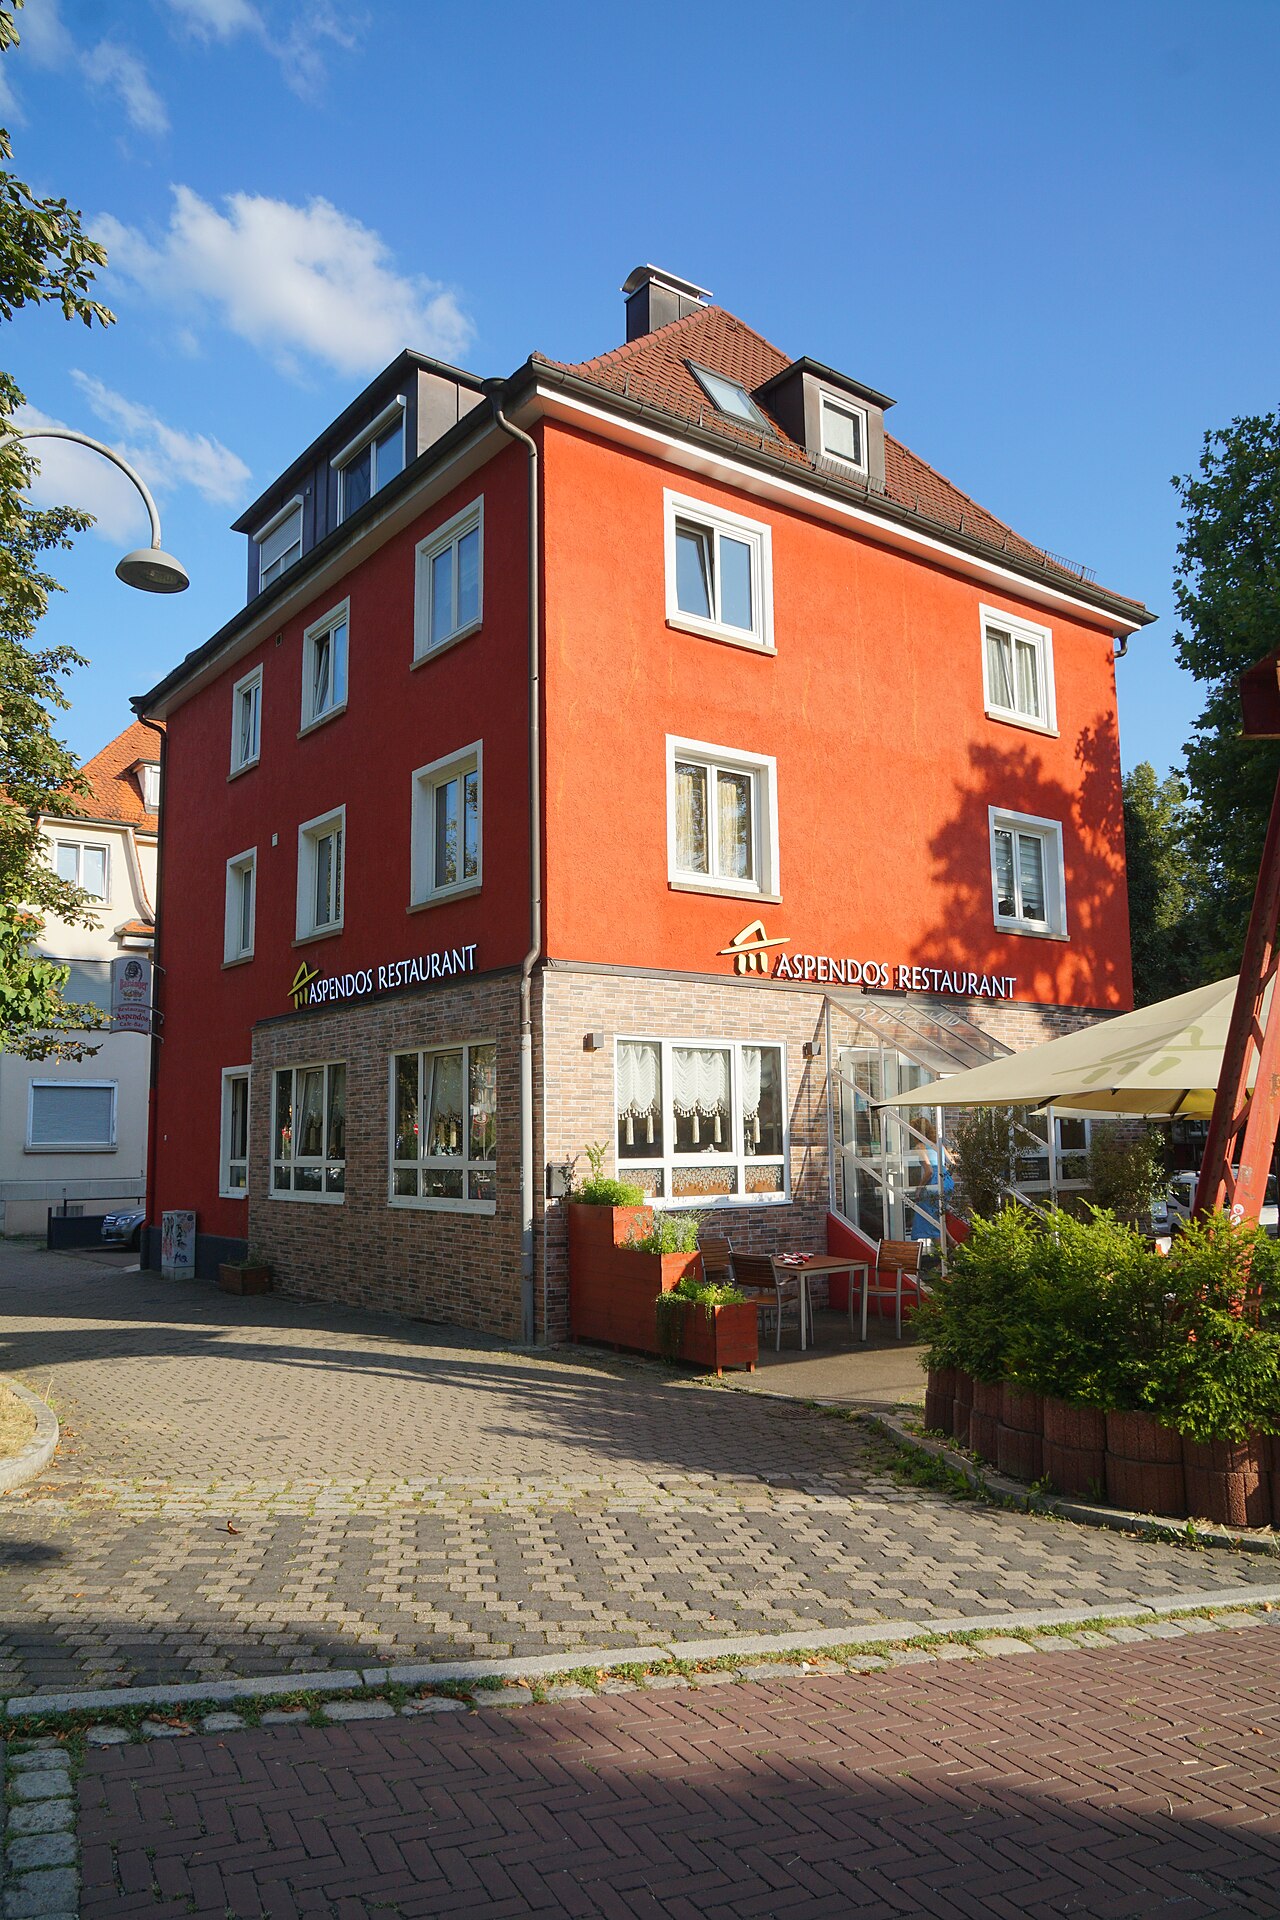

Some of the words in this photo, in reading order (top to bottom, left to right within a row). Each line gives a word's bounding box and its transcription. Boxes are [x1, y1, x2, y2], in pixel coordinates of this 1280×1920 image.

[309, 968, 373, 1004] ASPENDOS
[378, 943, 477, 990] RESTAURANT
[776, 952, 889, 986] ASPENDOS
[898, 964, 1017, 999] RESTAURANT
[116, 1012, 149, 1022] Aspendos
